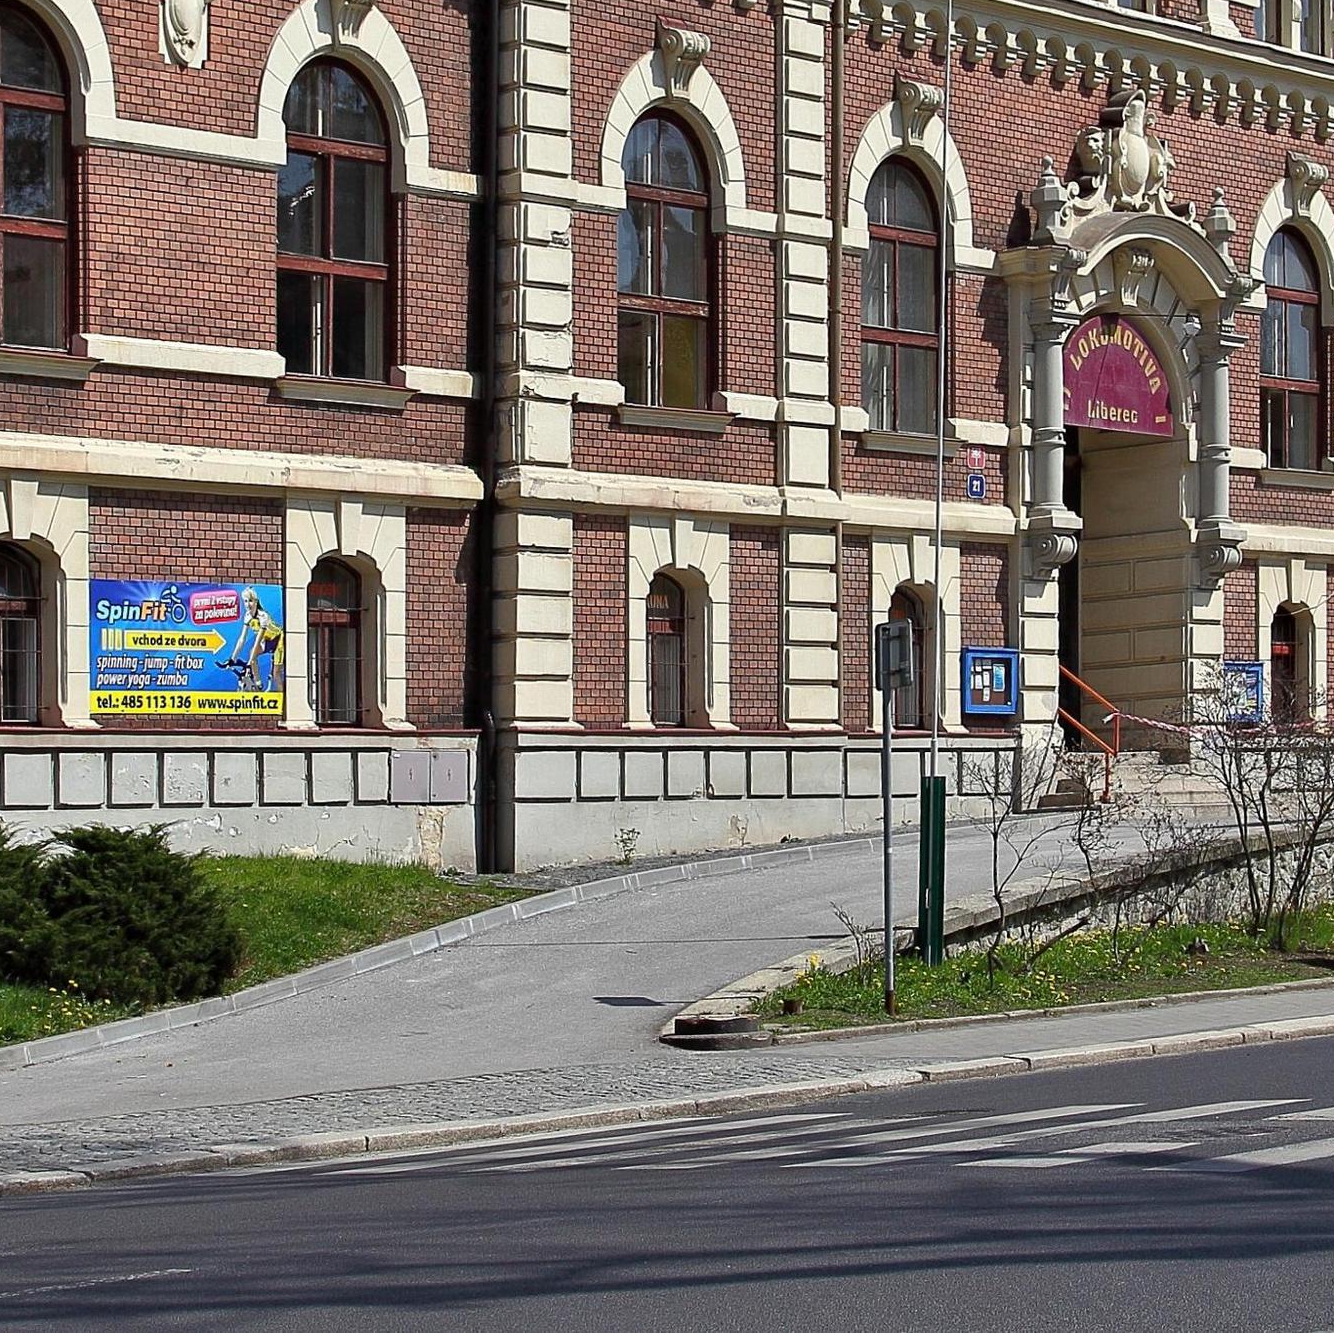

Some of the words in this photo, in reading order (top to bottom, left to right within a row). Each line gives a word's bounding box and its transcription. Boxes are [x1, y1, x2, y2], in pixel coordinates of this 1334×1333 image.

[1088, 400, 1139, 424] Liberec
[972, 479, 981, 492] 21
[96, 600, 167, 623] SpinFit
[132, 634, 163, 646] vchod
[165, 637, 176, 646] ze
[178, 635, 207, 646] dvora
[97, 653, 138, 672] spinning
[143, 653, 168, 673] jump
[174, 654, 185, 669] fit
[186, 654, 204, 669] box
[97, 673, 126, 688] power
[126, 673, 151, 689] yoga
[157, 672, 188, 686] zumba
[97, 694, 119, 708] tel.:
[121, 695, 143, 708] 485
[147, 696, 166, 709] 113
[171, 696, 191, 709] 136
[198, 696, 278, 712] www.spinfit.cz
